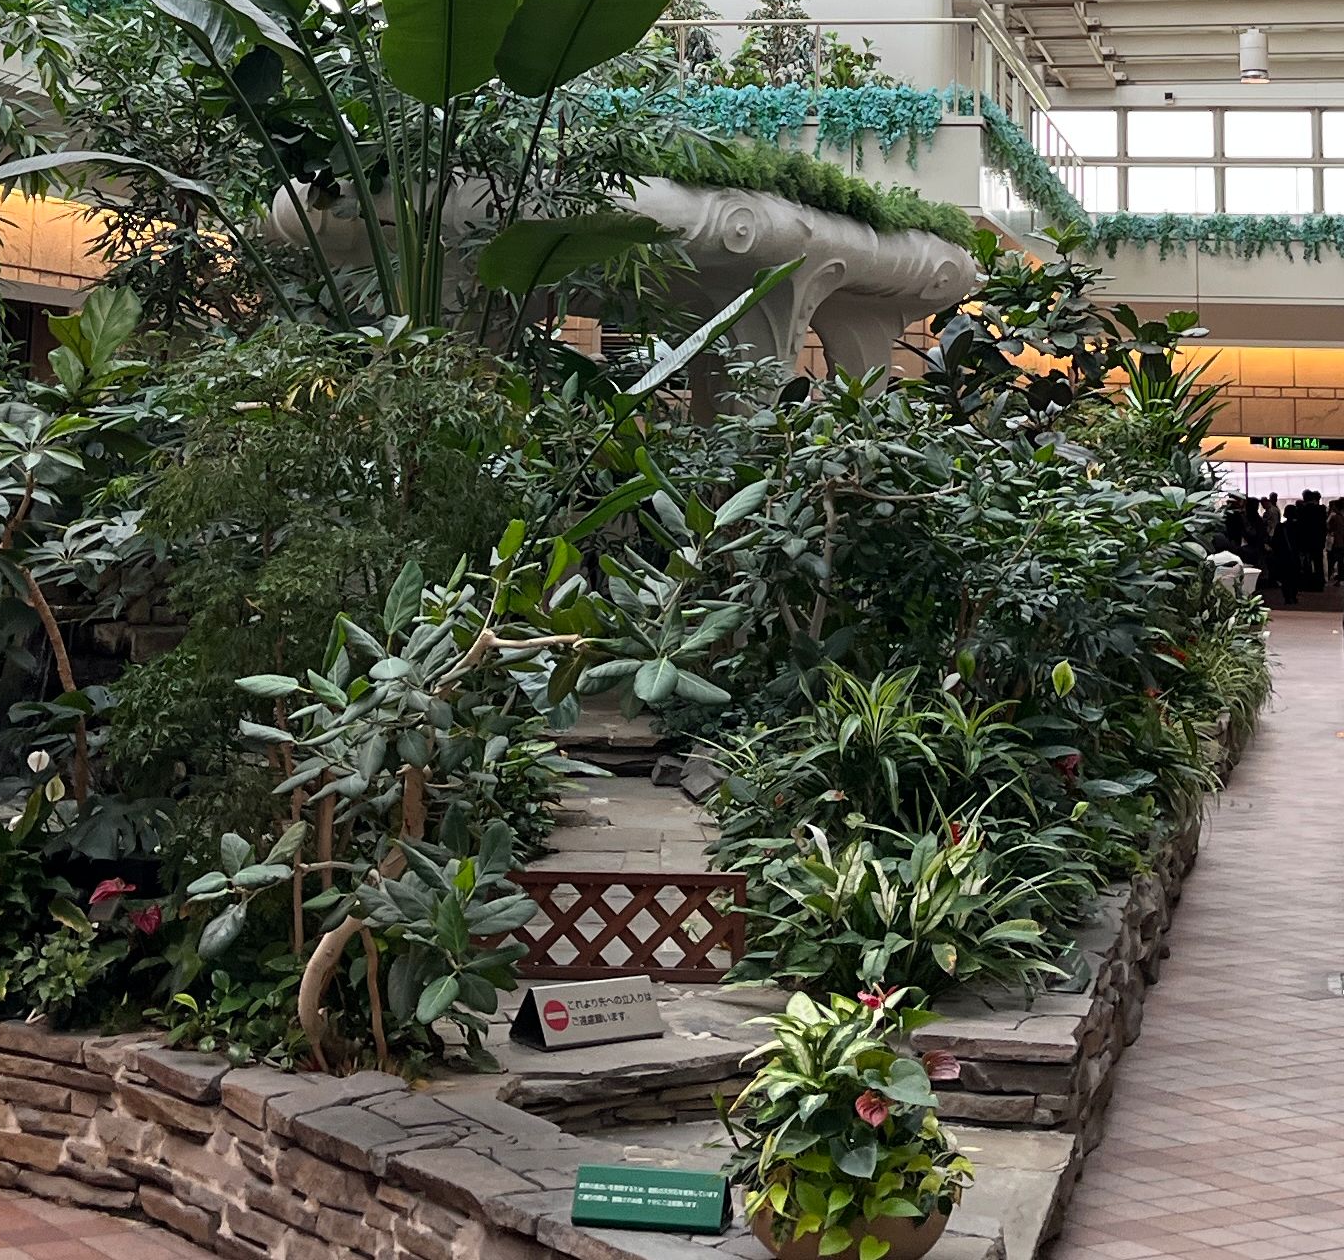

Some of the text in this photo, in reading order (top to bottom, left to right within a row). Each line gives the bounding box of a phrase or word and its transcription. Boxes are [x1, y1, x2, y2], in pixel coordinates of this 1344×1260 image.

[1278, 437, 1290, 449] 12
[1305, 438, 1318, 449] 14
[567, 992, 652, 1010] これより先への立入りは
